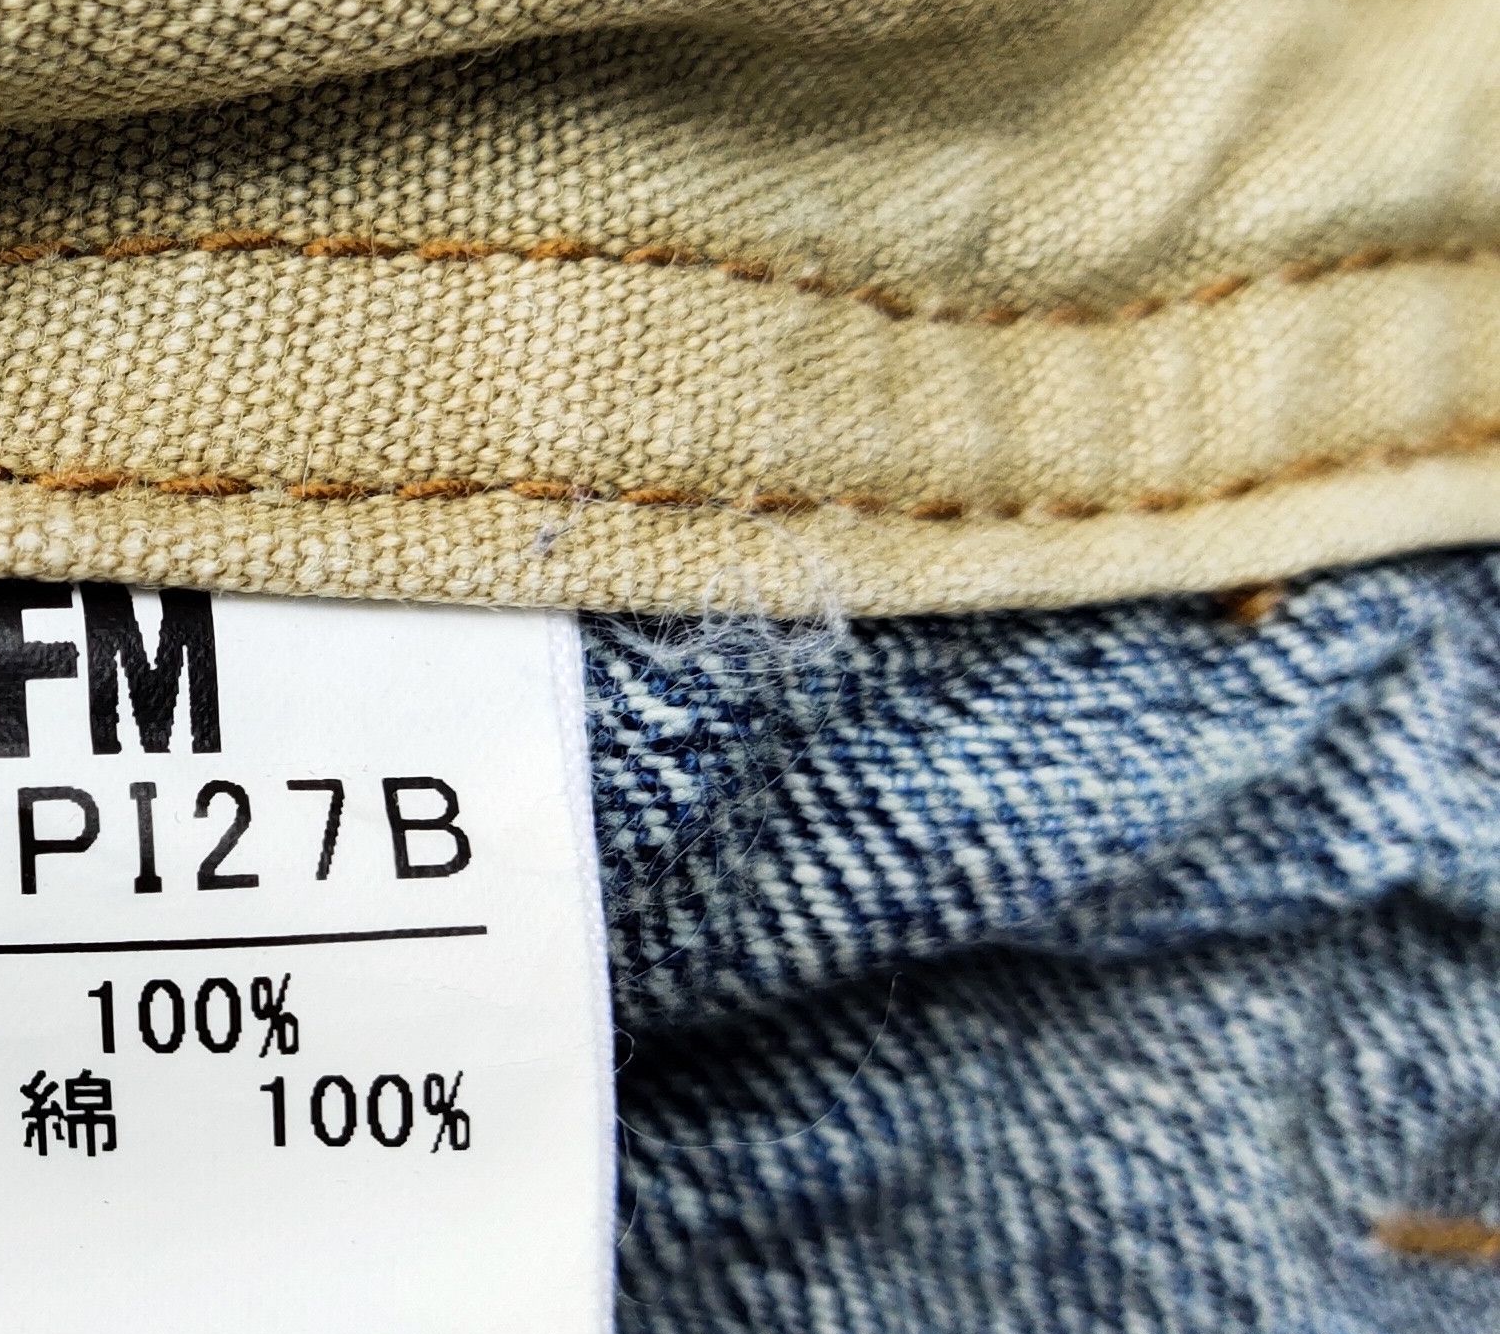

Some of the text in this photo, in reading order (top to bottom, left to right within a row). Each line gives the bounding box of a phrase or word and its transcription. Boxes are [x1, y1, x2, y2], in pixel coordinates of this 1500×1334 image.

[86, 971, 301, 1060] 100%
[18, 1067, 119, 1158] 綿
[258, 1069, 472, 1155] 100%
